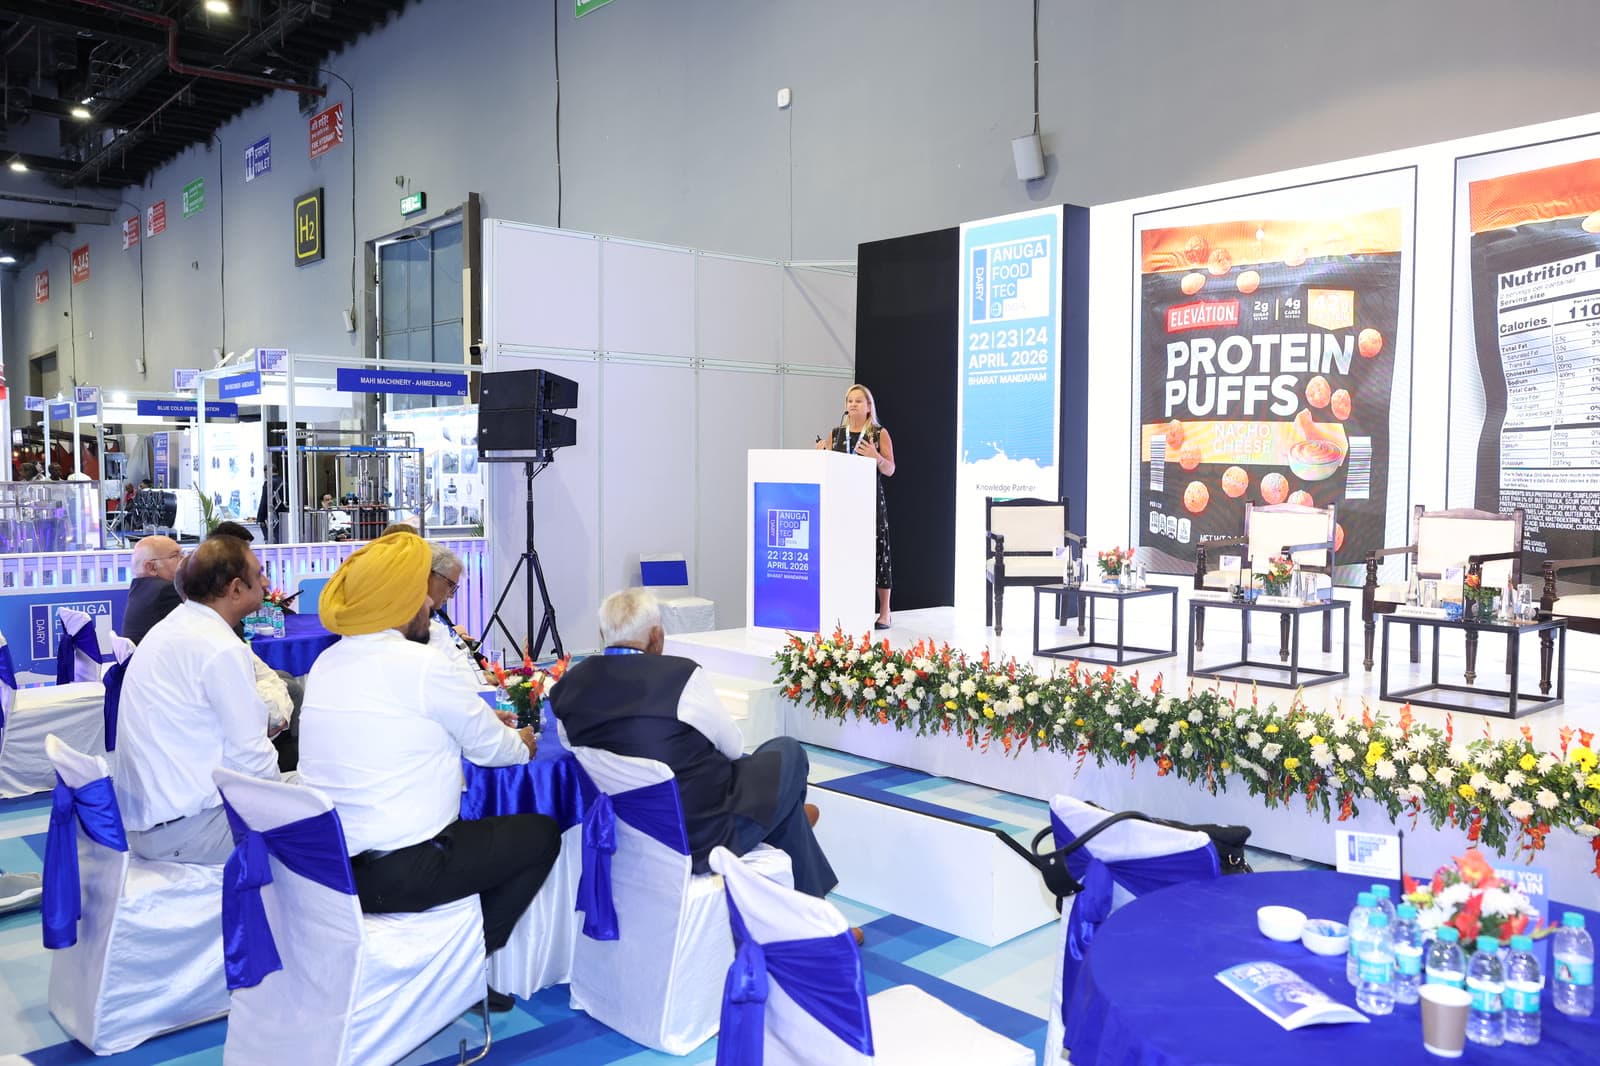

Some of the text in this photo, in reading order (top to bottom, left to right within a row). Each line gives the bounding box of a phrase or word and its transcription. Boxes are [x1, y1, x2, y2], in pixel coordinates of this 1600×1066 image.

[300, 214, 314, 243] H2
[992, 241, 1045, 263] ANUGA
[992, 262, 1030, 280] FOOD
[1501, 260, 1586, 290] Nutrition
[975, 266, 984, 302] DAIRY
[992, 283, 1016, 299] TEC
[1254, 301, 1268, 313] 2g
[1284, 298, 1300, 310] 4g
[1500, 297, 1528, 307] Serving
[1569, 303, 1600, 319] 110
[1500, 317, 1548, 334] Calories
[1166, 333, 1355, 379] PROTEIN
[1501, 345, 1516, 353] Total
[968, 349, 1048, 369] APRIL 2026
[968, 372, 1047, 385] BHARAT MANDAPAM
[1506, 368, 1538, 378] Cholesterol
[376, 378, 412, 386] MACHINERY
[416, 380, 452, 388] AHMEDABAD
[1164, 374, 1300, 418] PUFFS
[1214, 424, 1271, 438] NACHO
[1213, 440, 1272, 453] CHEESE
[976, 484, 1036, 493] Knowledge Partner
[780, 512, 806, 521] ANUGA
[767, 561, 808, 571] APRIL 2026
[36, 620, 46, 645] DAIRY
[1518, 872, 1544, 882] YOU
